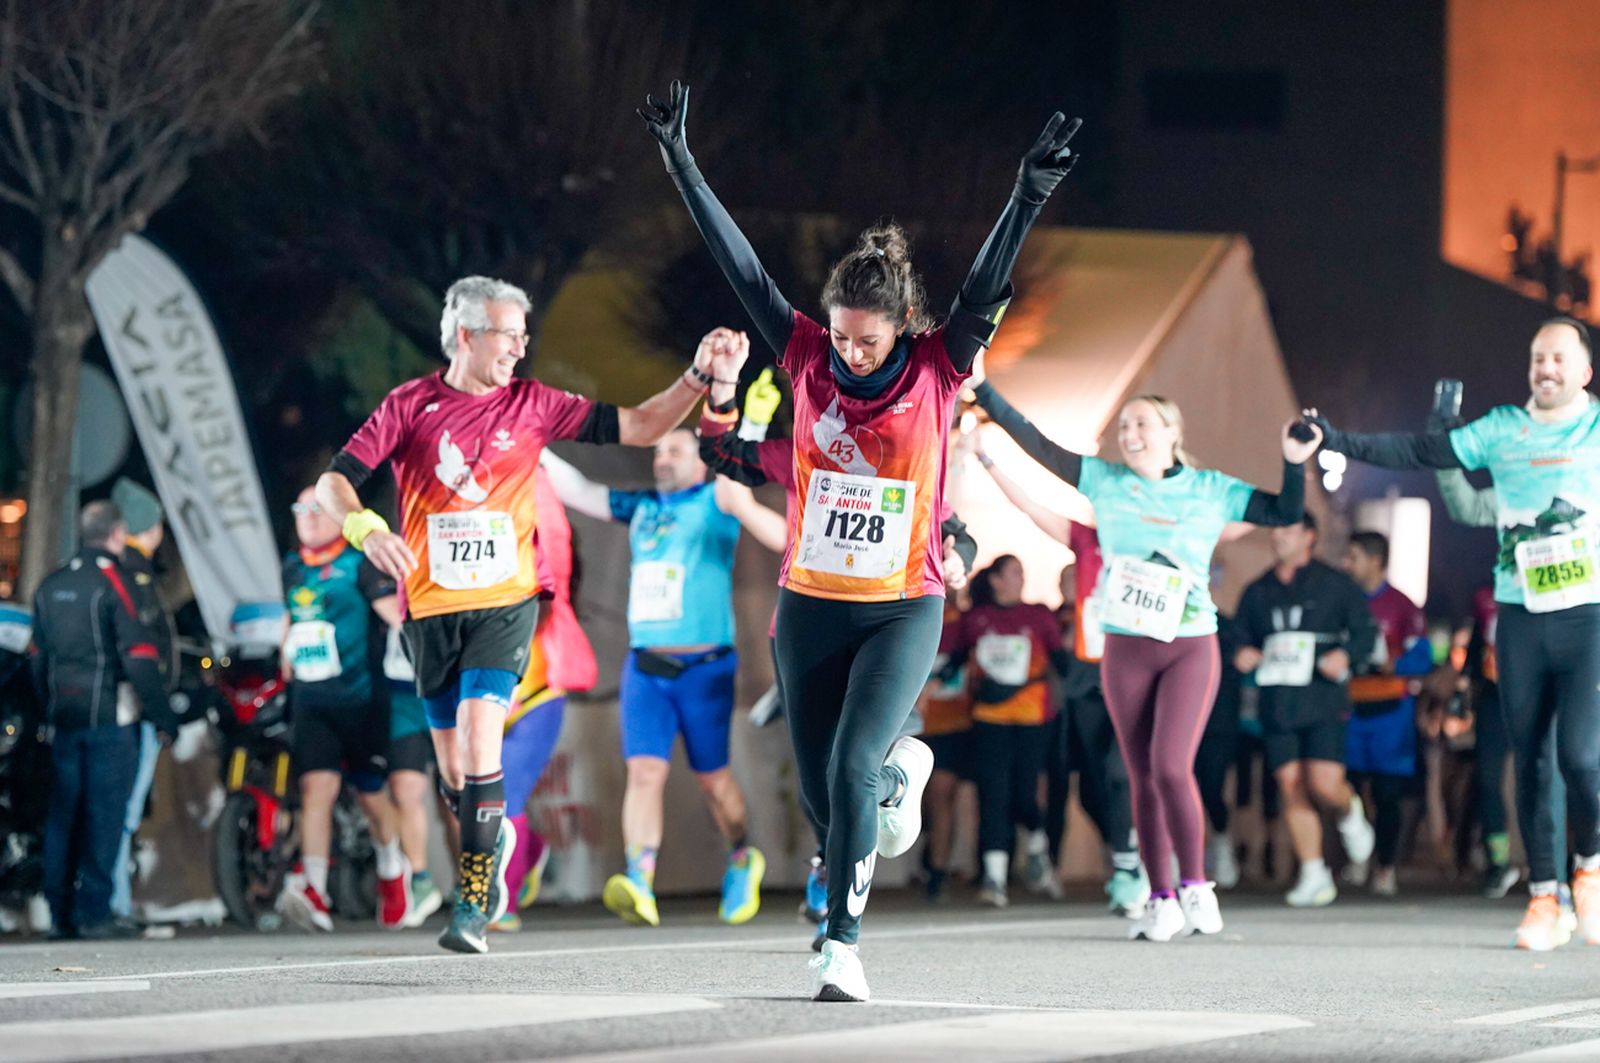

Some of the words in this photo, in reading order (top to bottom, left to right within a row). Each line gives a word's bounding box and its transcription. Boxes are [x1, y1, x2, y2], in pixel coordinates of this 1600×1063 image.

[157, 287, 261, 536] JAPEMASA
[827, 439, 855, 464] 43
[835, 496, 872, 511] ANTÓN
[860, 487, 873, 498] DE
[448, 539, 496, 562] 7274
[1535, 560, 1585, 587] 2855
[1121, 584, 1167, 613] 2166
